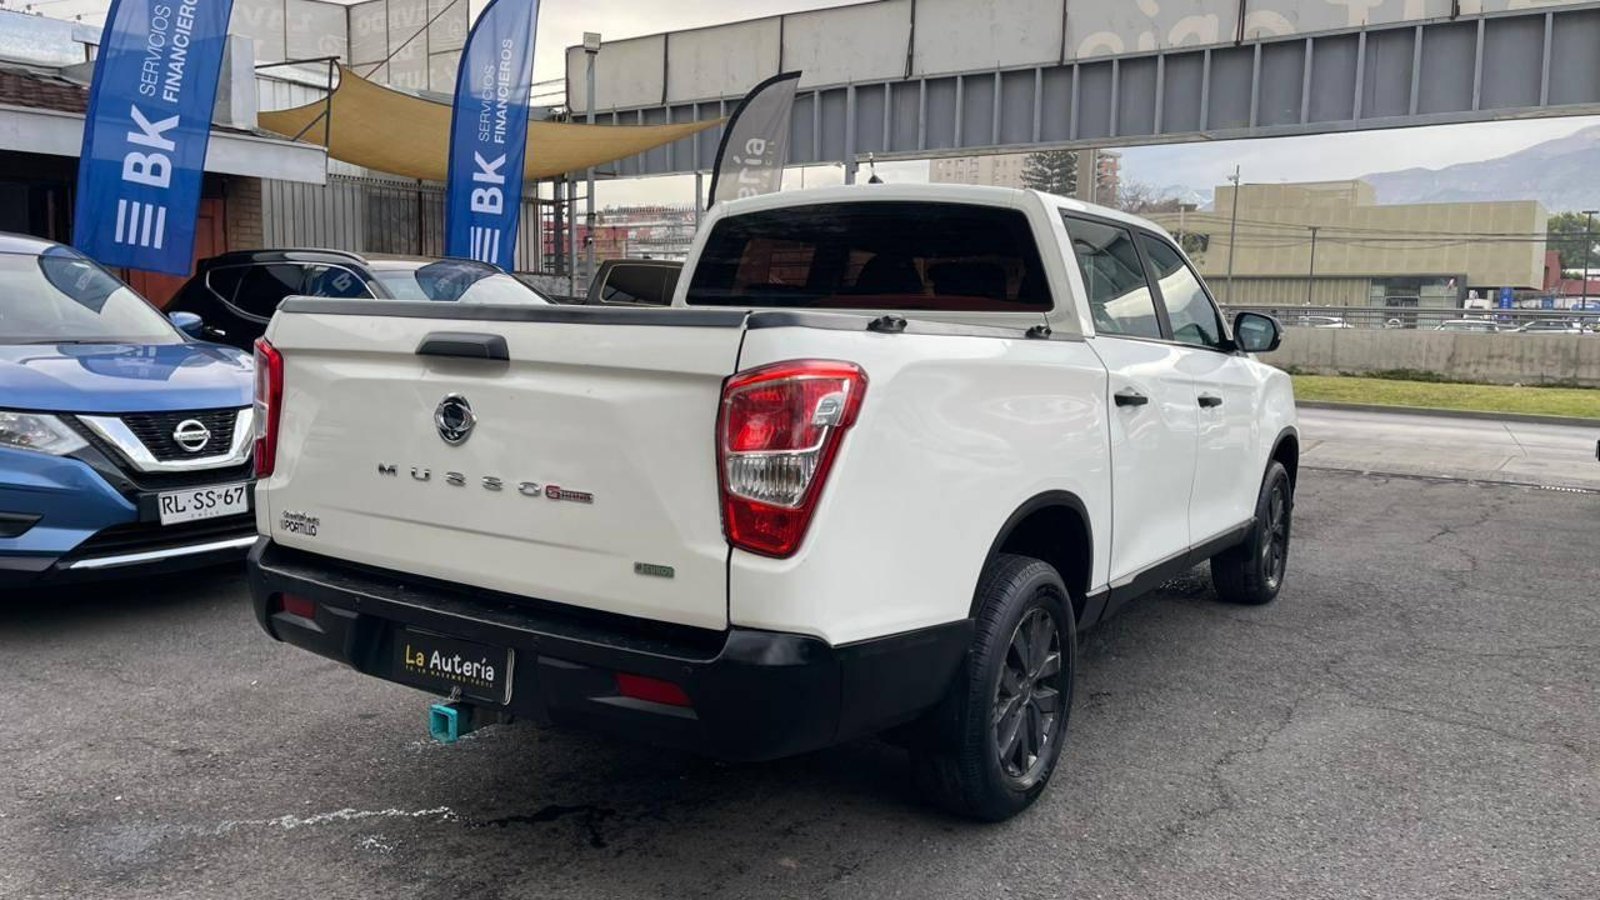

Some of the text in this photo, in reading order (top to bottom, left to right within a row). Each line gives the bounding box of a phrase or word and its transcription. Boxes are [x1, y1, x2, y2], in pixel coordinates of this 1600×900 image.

[139, 4, 171, 97] SERVICIOS
[478, 64, 495, 142] SERVICIOS
[494, 38, 513, 144] FINANCIEROS
[121, 104, 180, 189] BK
[470, 150, 506, 215] BK
[378, 463, 541, 497] MUSSO
[405, 644, 425, 667] La
[429, 650, 495, 681] Autería
